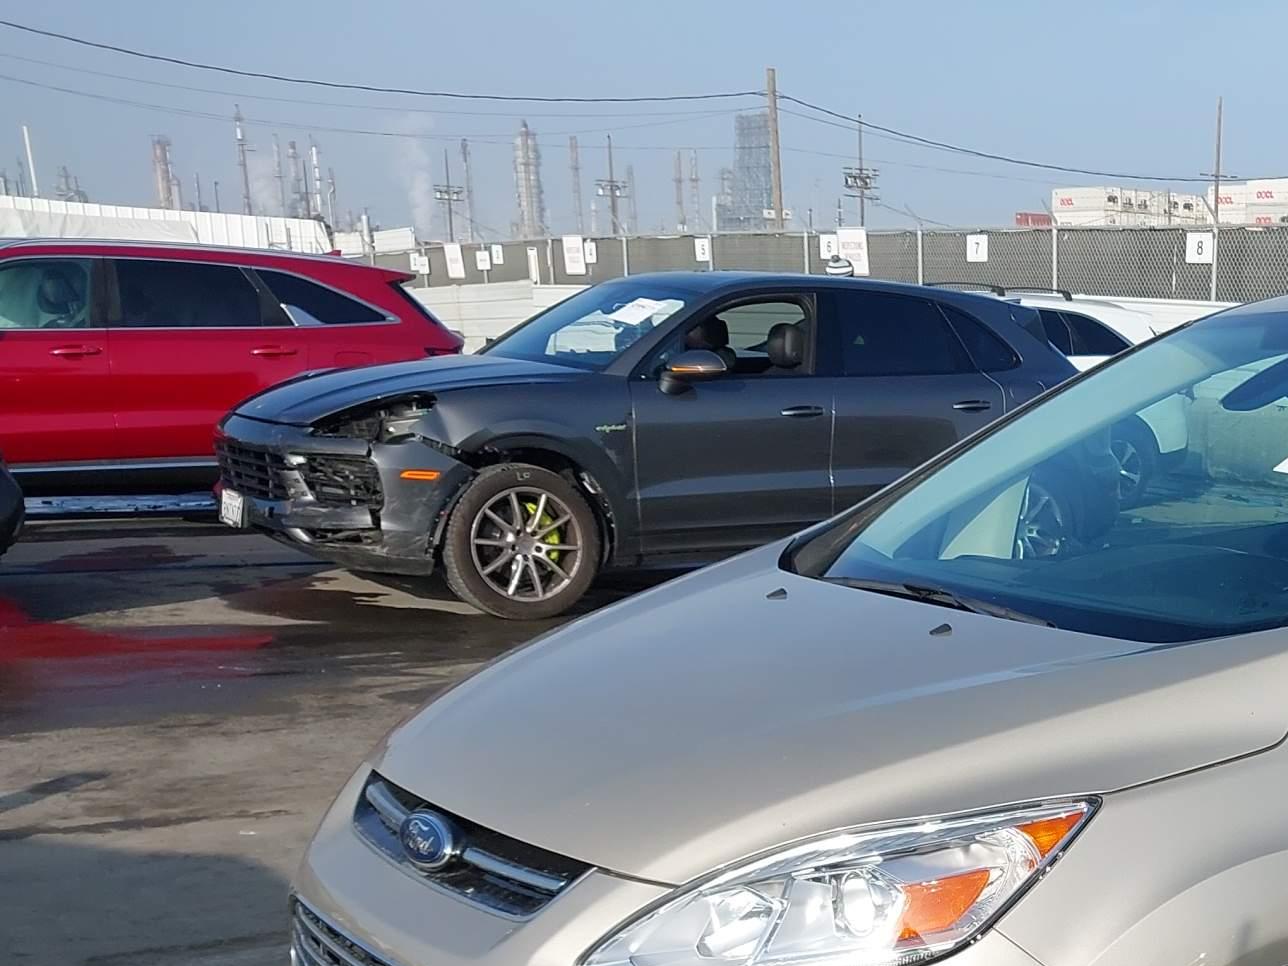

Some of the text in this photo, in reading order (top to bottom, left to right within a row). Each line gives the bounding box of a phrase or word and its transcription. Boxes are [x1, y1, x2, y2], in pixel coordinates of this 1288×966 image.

[974, 241, 980, 255] 7
[1197, 240, 1203, 255] 8
[408, 819, 434, 855] Ford
